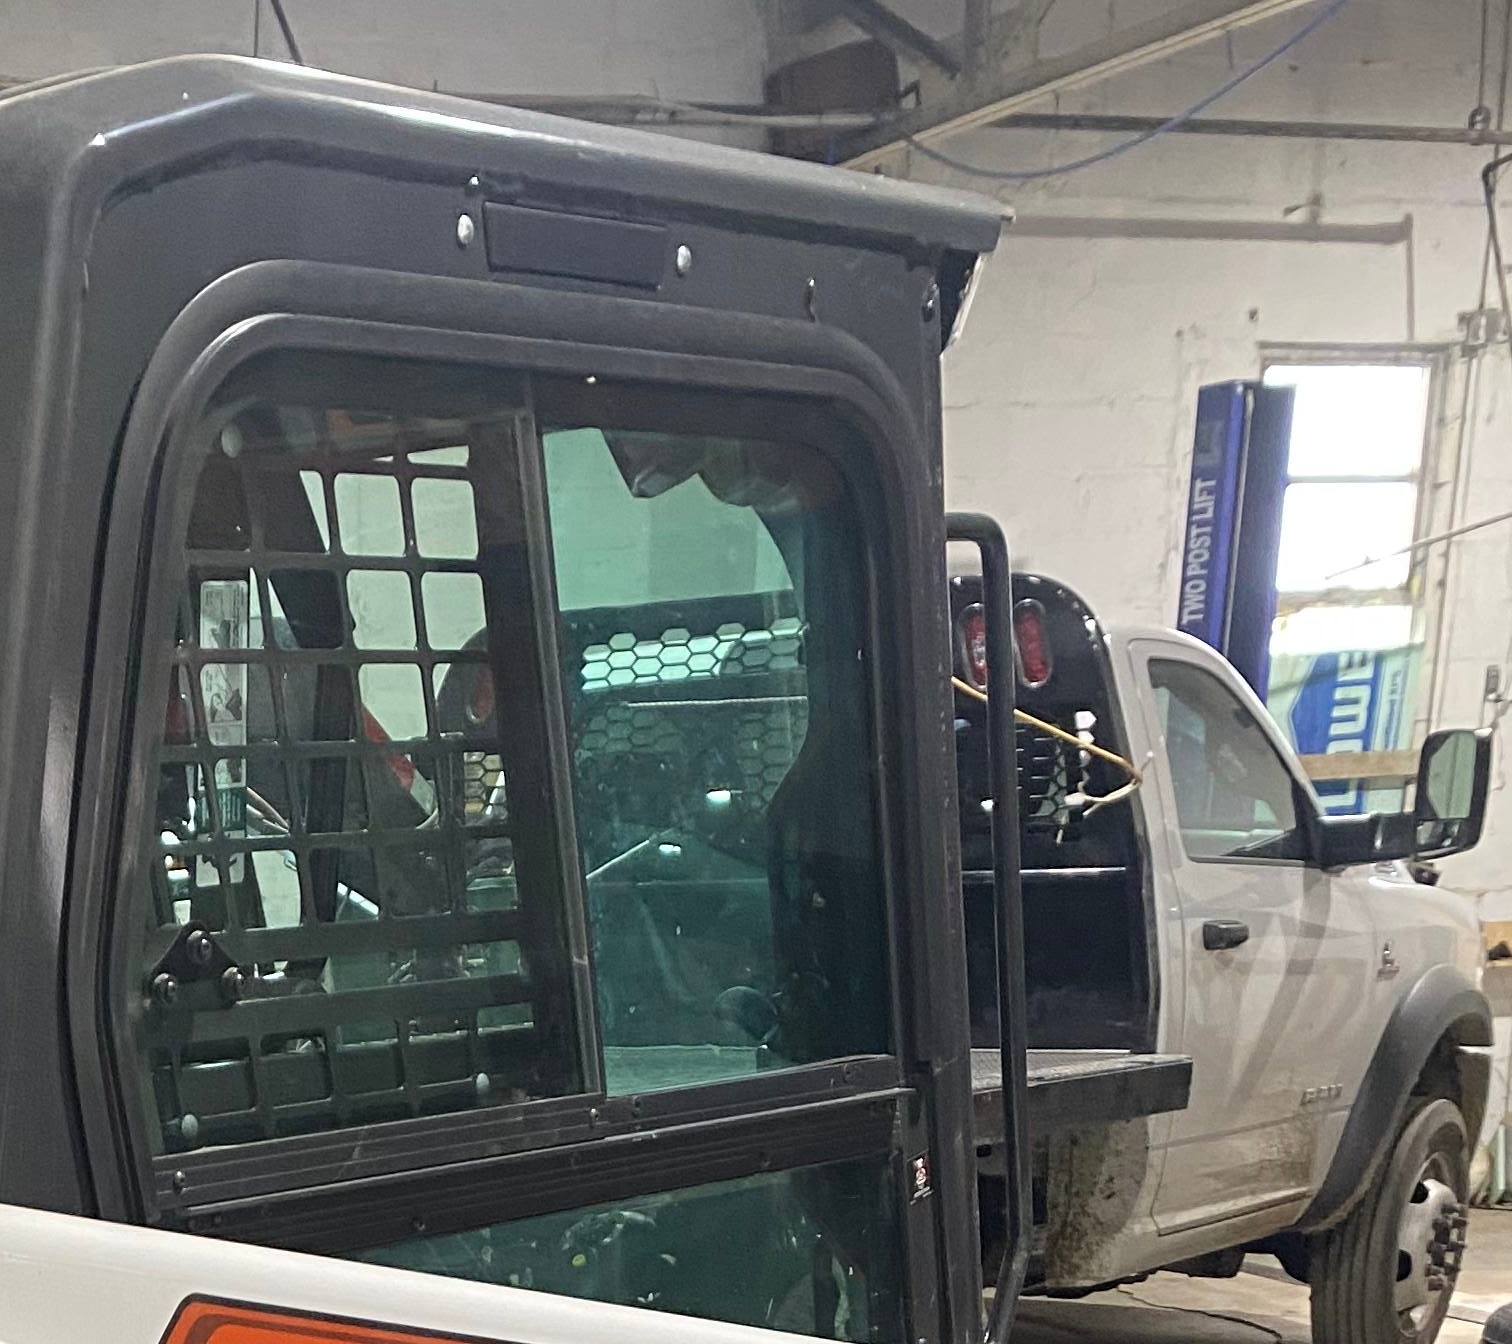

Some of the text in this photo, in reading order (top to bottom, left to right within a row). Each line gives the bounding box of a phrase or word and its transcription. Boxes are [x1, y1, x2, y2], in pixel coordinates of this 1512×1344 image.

[1182, 477, 1217, 625] TWO POST LIFT
